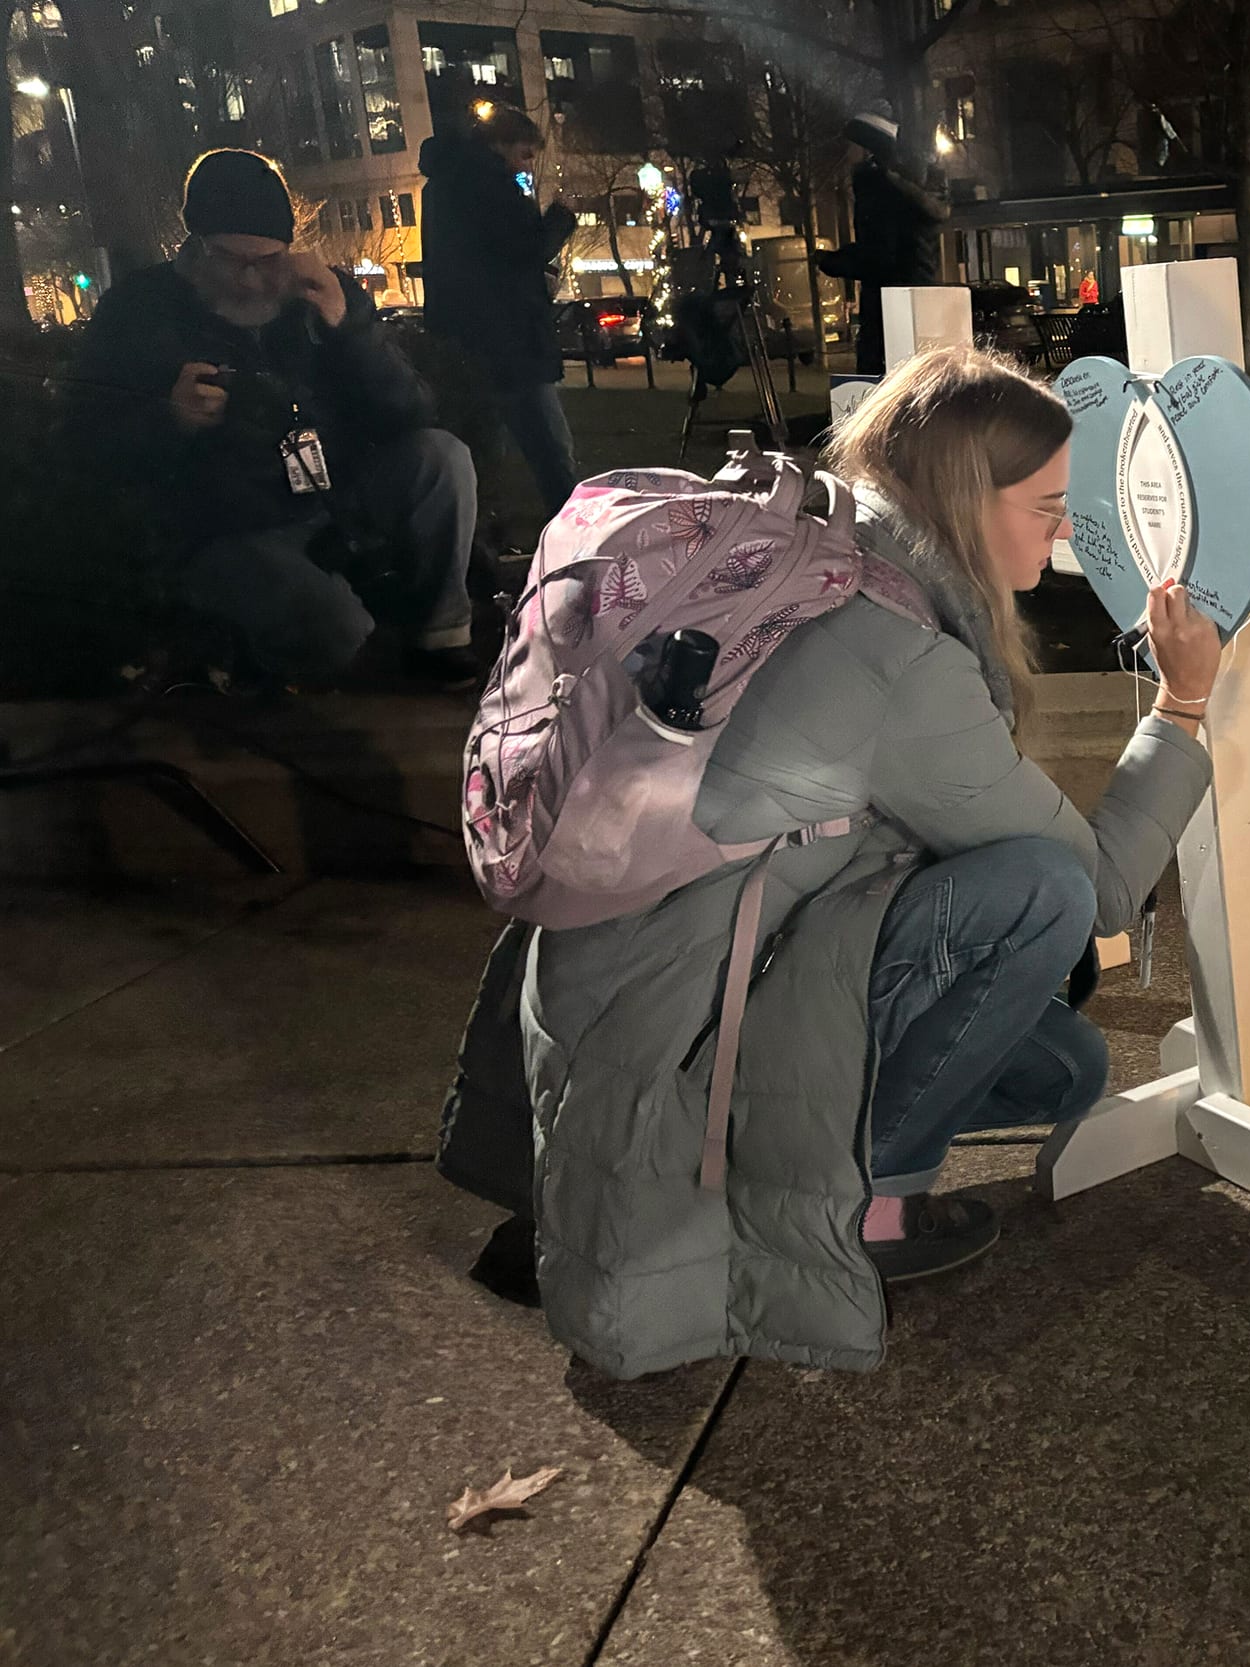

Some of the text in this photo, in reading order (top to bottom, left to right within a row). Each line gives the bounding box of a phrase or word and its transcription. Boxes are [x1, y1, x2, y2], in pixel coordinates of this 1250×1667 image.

[1118, 408, 1139, 477] brokenhearted
[1140, 480, 1162, 489] THIS AREA
[1157, 424, 1170, 444] and
[1166, 443, 1179, 471] saves
[1175, 471, 1183, 490] the
[1179, 491, 1188, 534] crushed
[1121, 508, 1132, 532] near
[1131, 542, 1145, 566] Lord
[1143, 564, 1154, 584] The
